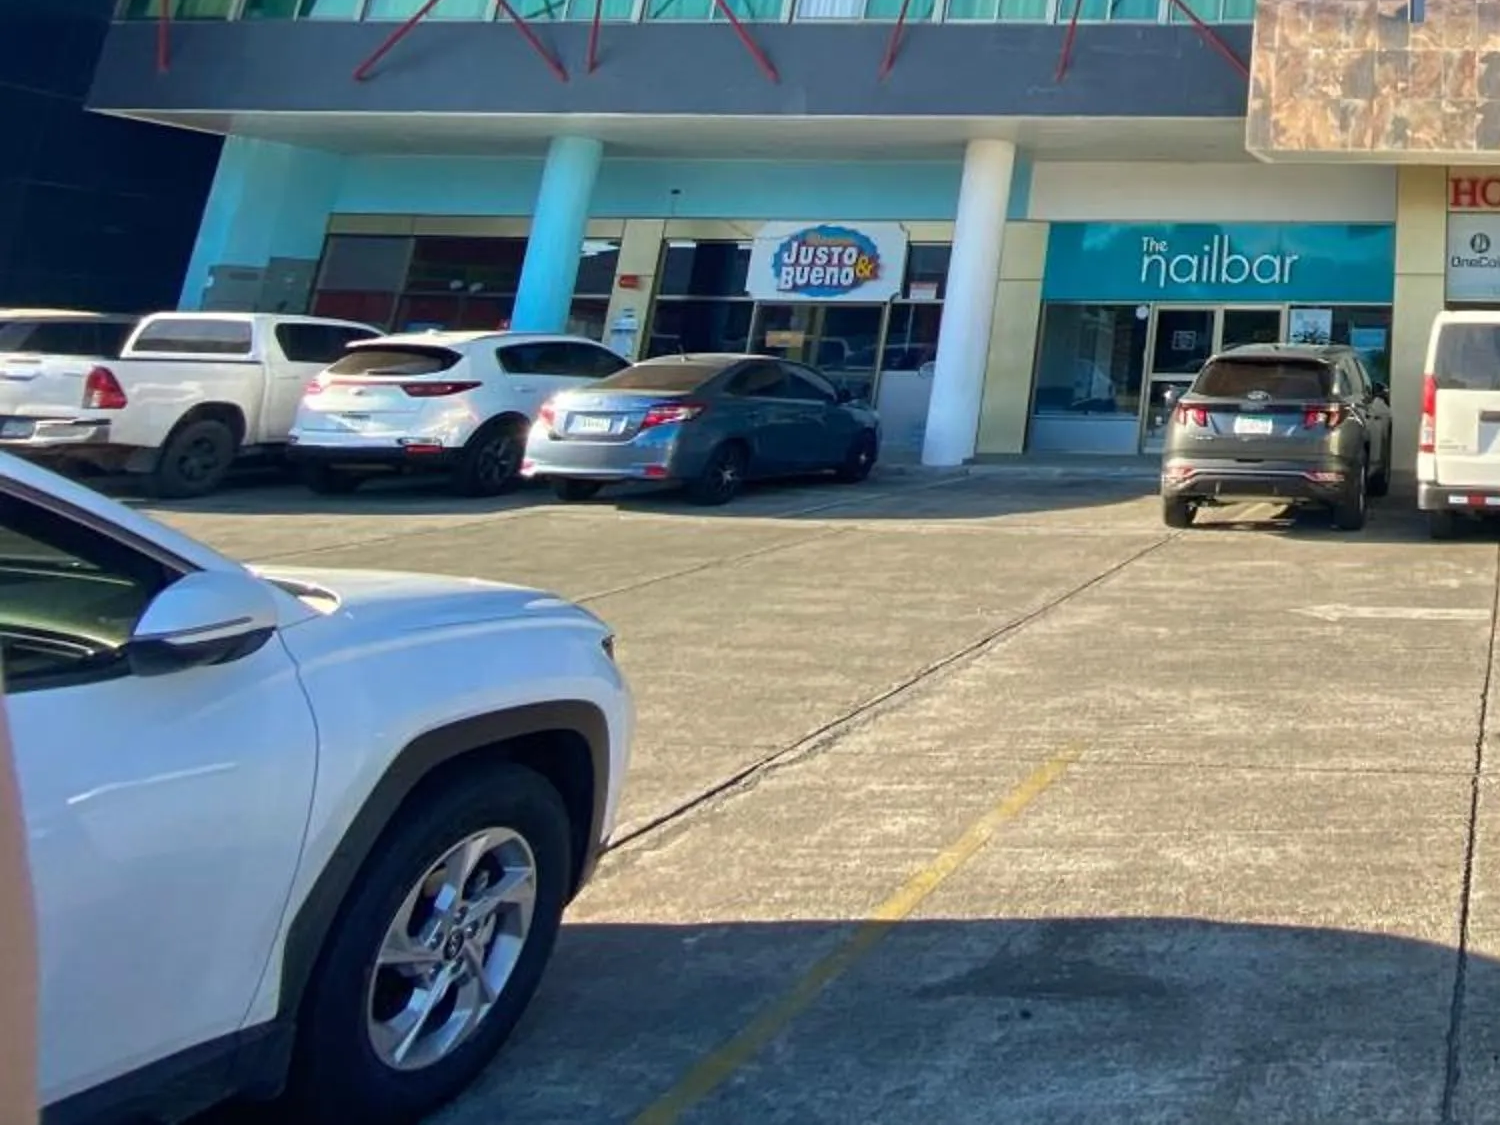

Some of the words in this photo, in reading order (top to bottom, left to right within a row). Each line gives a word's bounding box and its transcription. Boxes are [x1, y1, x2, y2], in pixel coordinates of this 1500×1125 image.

[1142, 236, 1168, 253] The
[855, 254, 873, 279] &
[1141, 234, 1299, 288] nailbar
